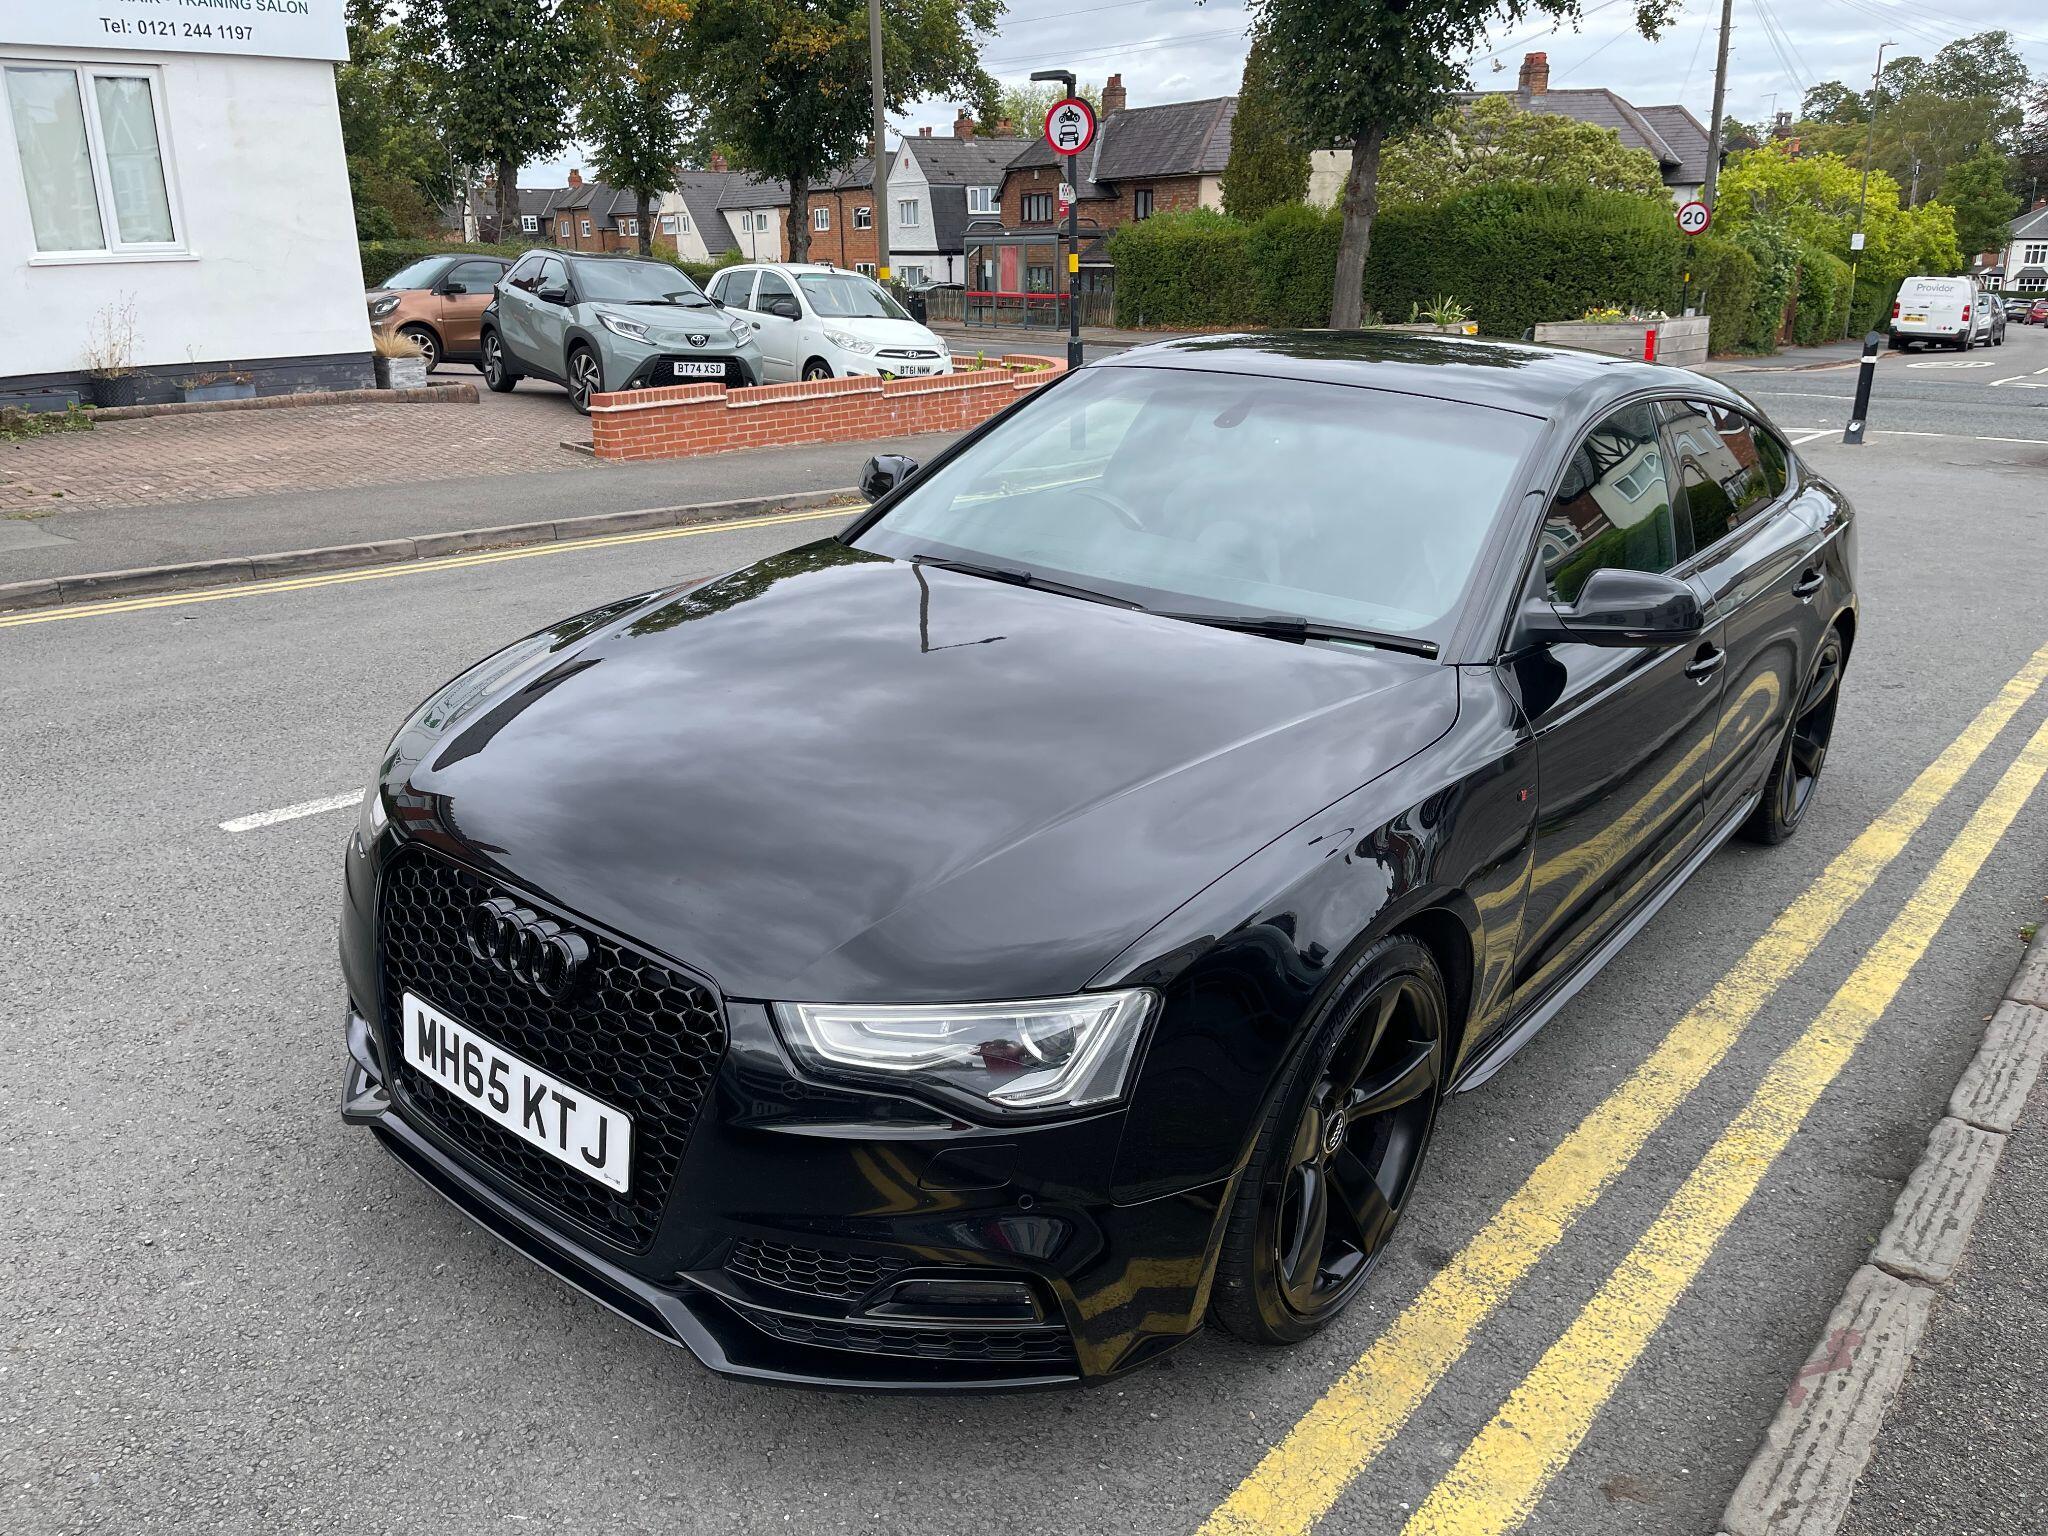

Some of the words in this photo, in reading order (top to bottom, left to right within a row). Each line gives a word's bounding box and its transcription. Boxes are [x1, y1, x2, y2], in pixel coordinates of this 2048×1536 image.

[256, 0, 309, 14] SALON
[99, 17, 132, 34] Tel:
[137, 19, 177, 37] 0121
[182, 22, 213, 38] 244
[217, 24, 253, 41] 1197
[1682, 211, 1705, 225] 20
[1916, 283, 1955, 292] Providor
[677, 363, 702, 374] BT74
[704, 364, 722, 374] XSD
[417, 1009, 510, 1115] MH65
[523, 1074, 608, 1169] KTJ
